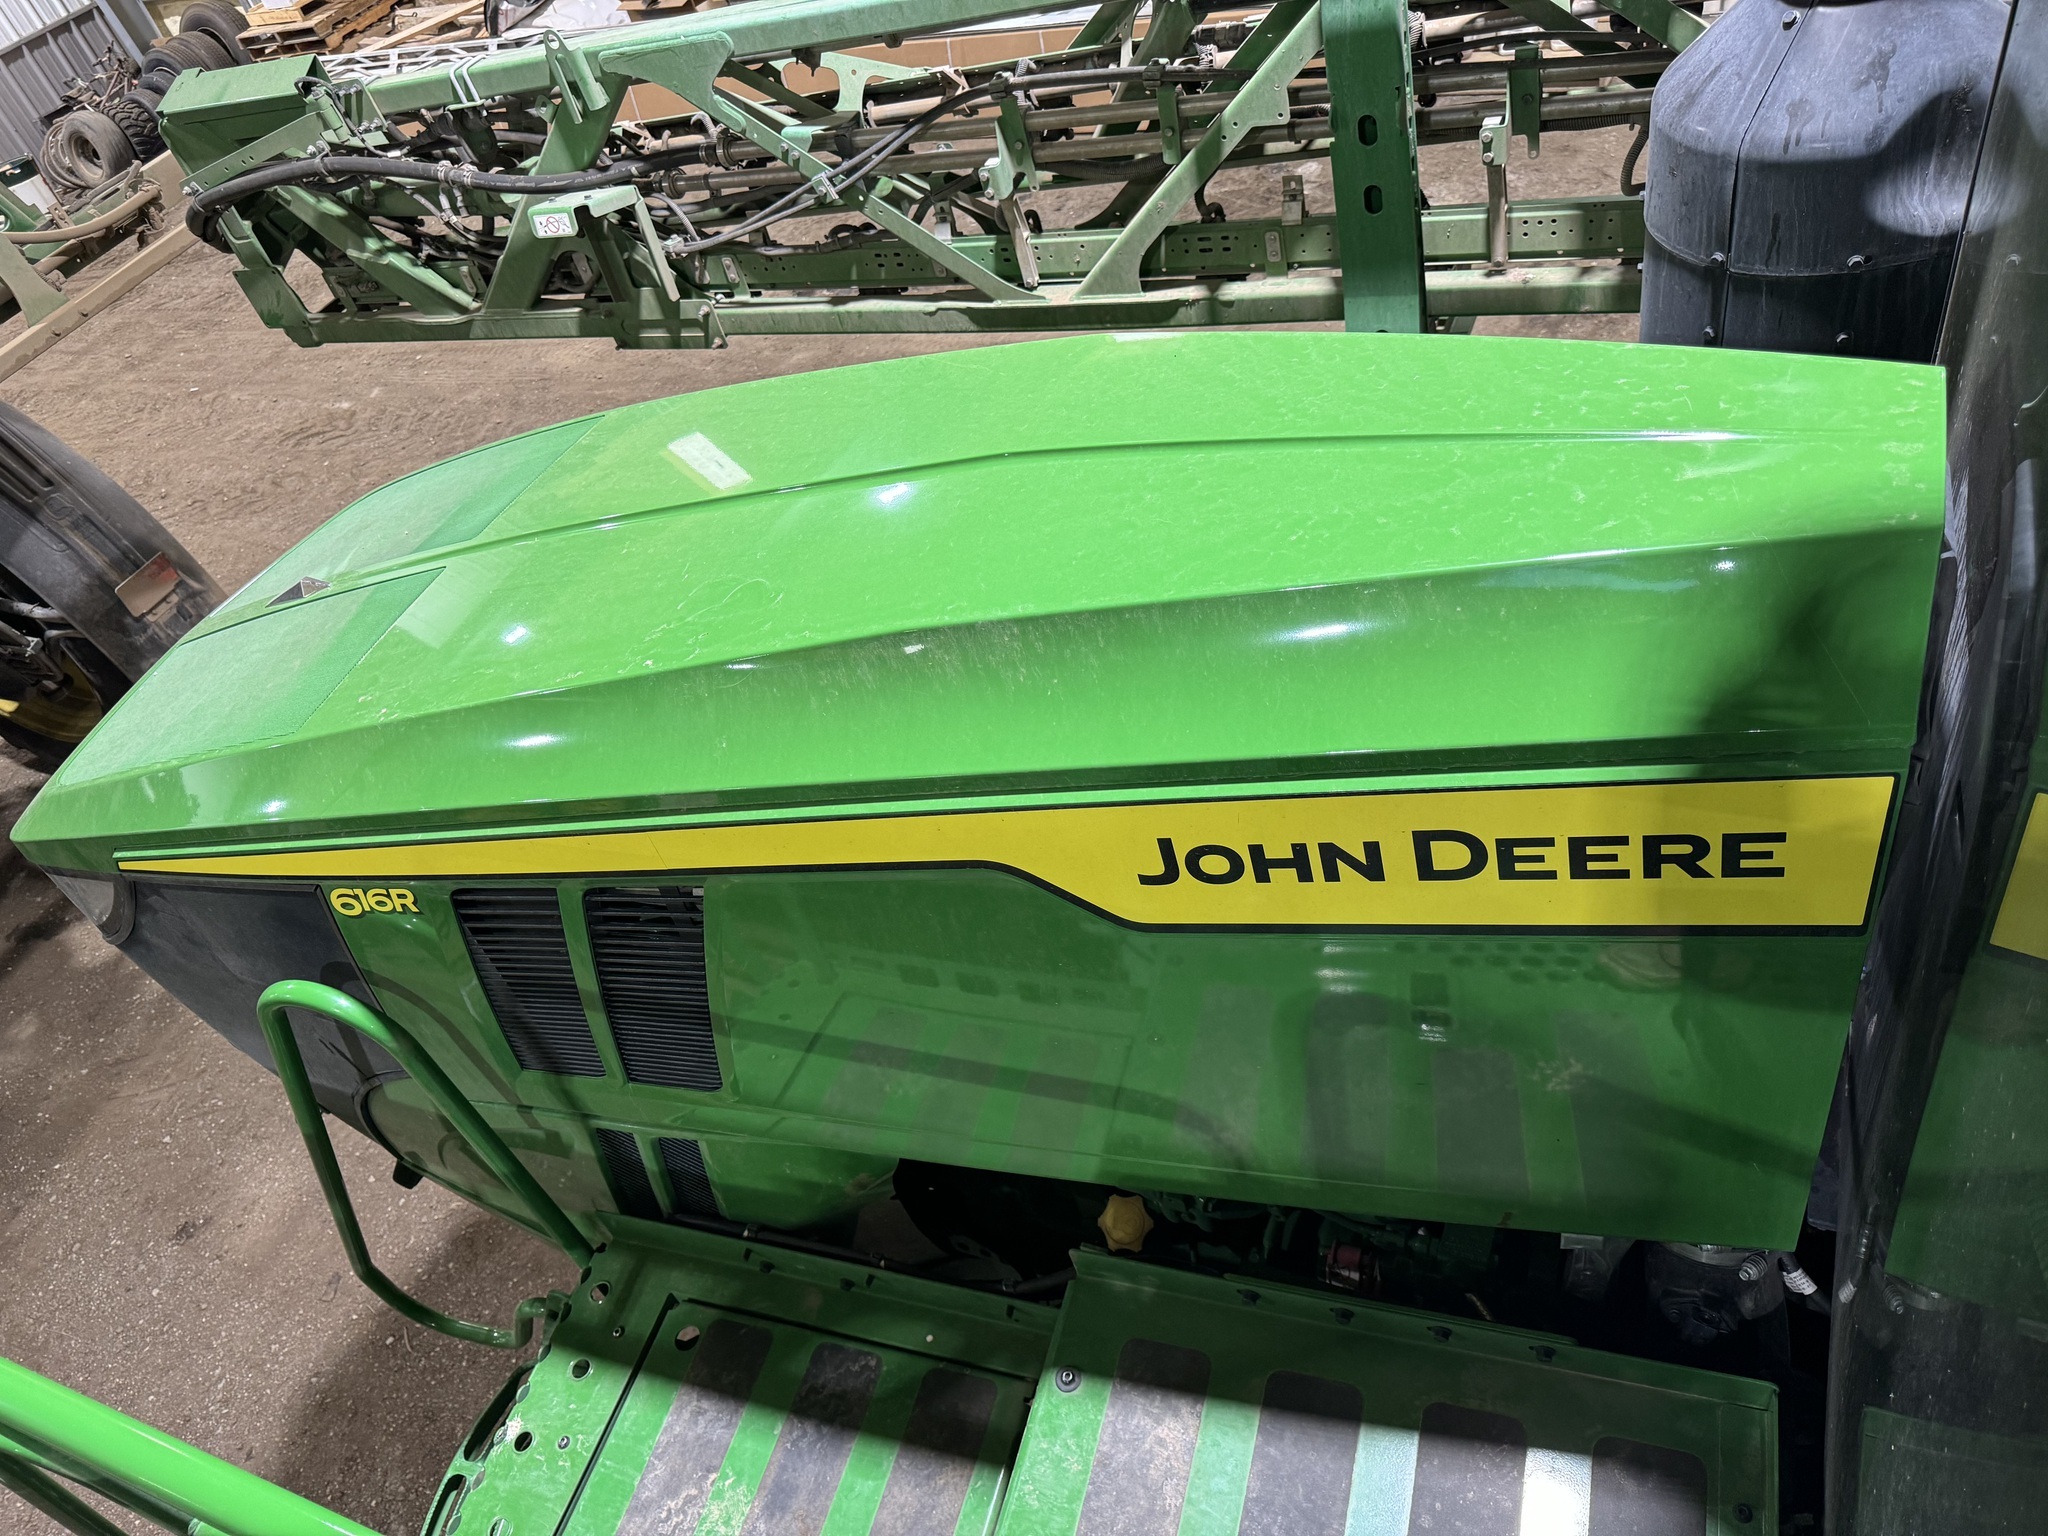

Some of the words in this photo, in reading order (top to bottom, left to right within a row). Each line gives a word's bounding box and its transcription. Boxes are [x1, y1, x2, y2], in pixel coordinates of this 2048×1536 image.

[1137, 837, 1386, 886] JOHN
[1411, 829, 1788, 882] DEERE
[330, 887, 421, 917] 616R
